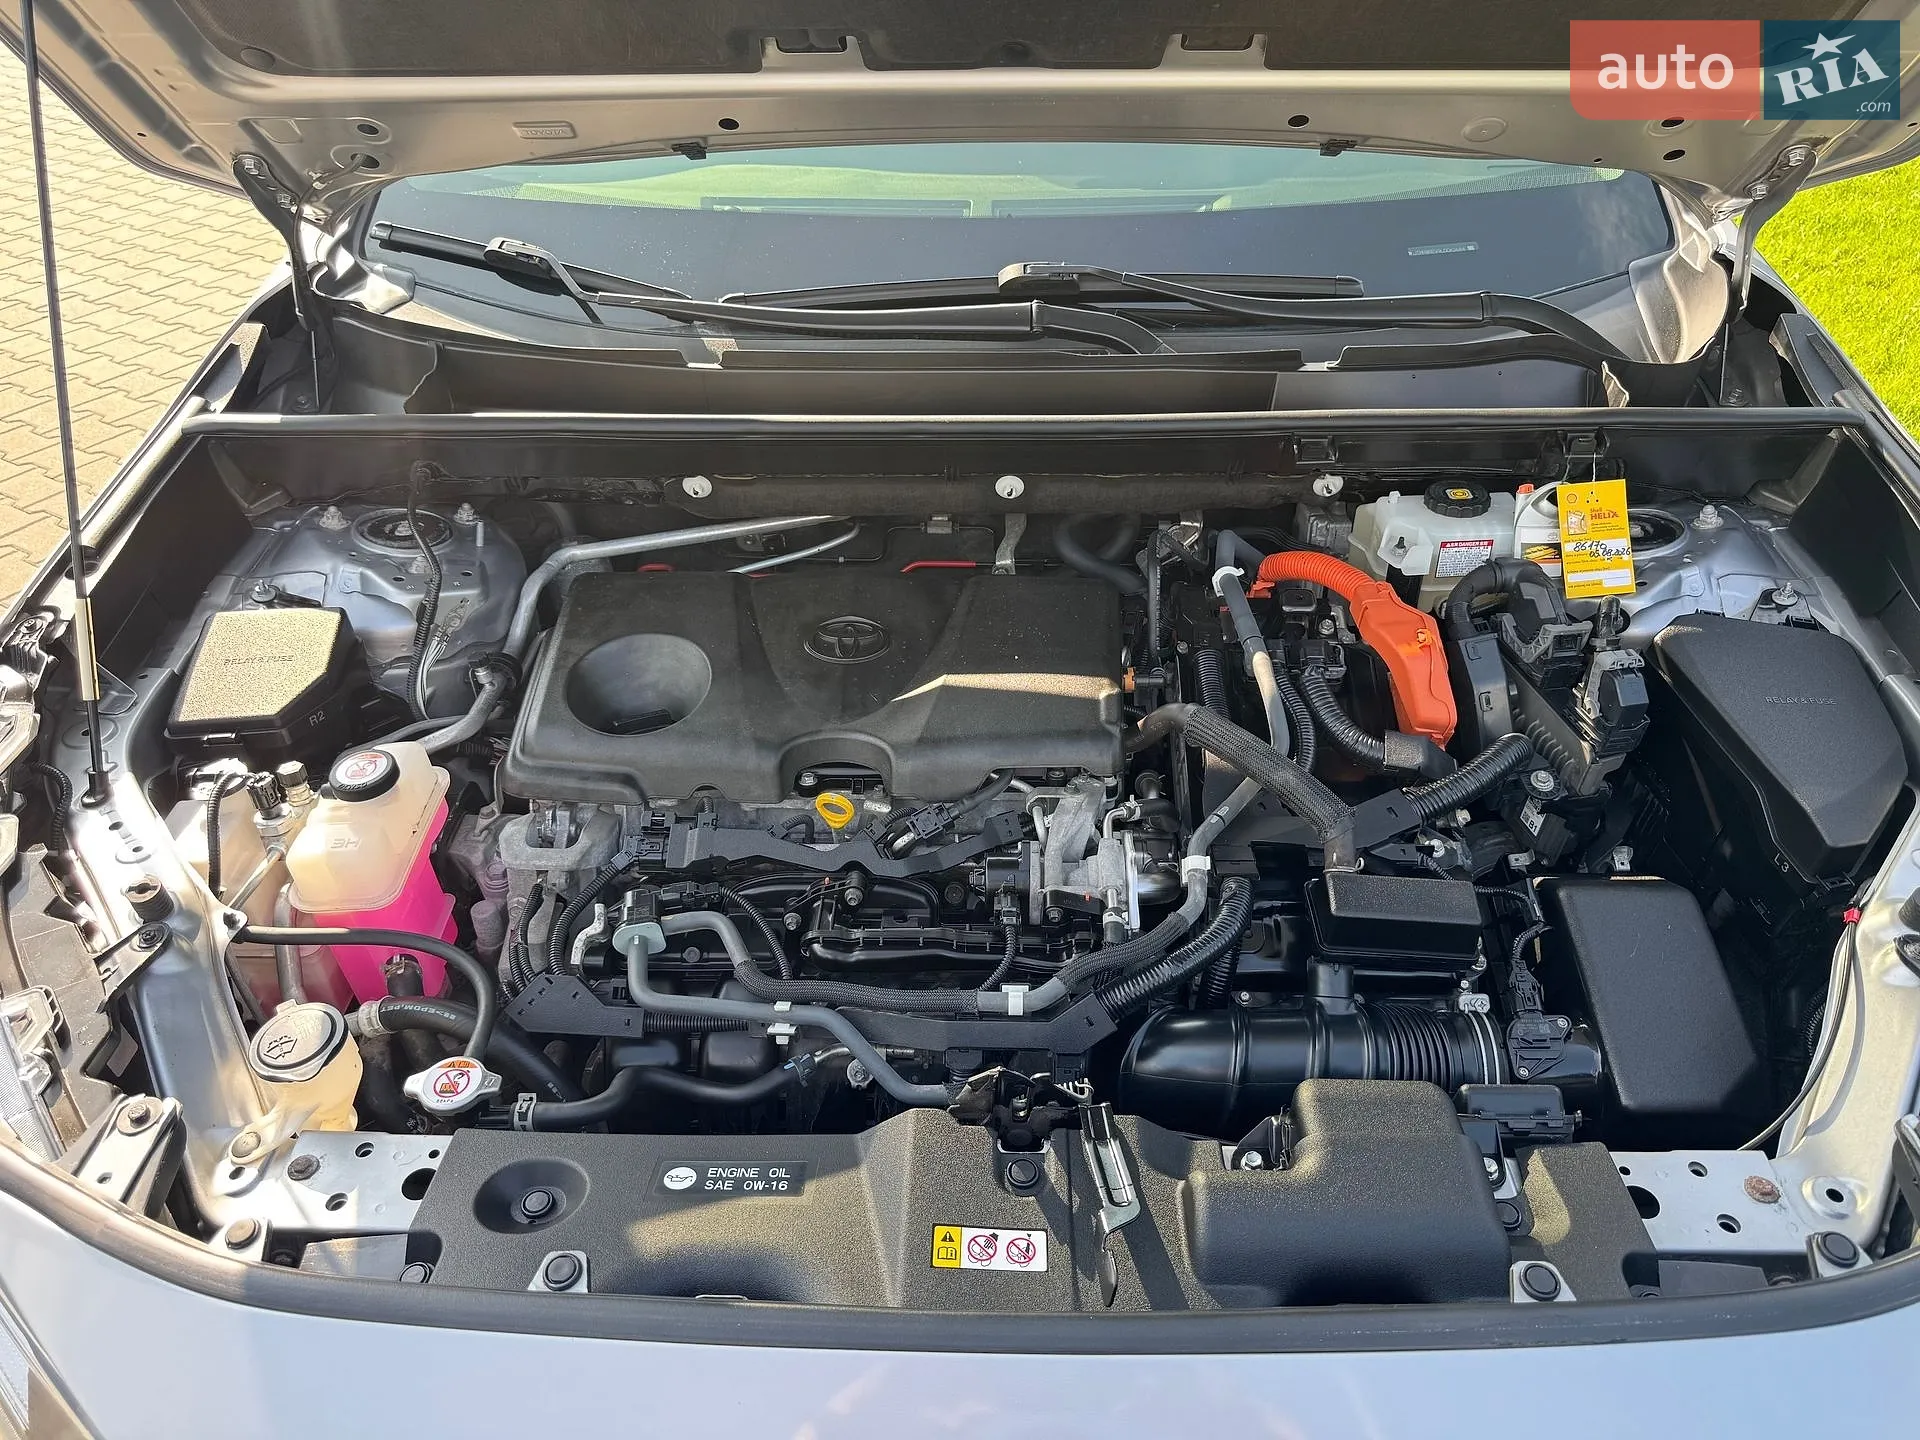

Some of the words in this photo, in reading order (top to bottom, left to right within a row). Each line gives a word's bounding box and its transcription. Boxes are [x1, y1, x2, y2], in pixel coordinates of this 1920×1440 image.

[1590, 511, 1619, 520] HELIX
[1765, 696, 1799, 704] RELAY
[1808, 697, 1837, 705] FUSE
[309, 710, 326, 726] R2
[1528, 820, 1537, 833] B1
[707, 1167, 760, 1178] ENGINE
[769, 1167, 791, 1178] OIL
[704, 1180, 735, 1191] SAE
[743, 1180, 789, 1191] 0W-16
